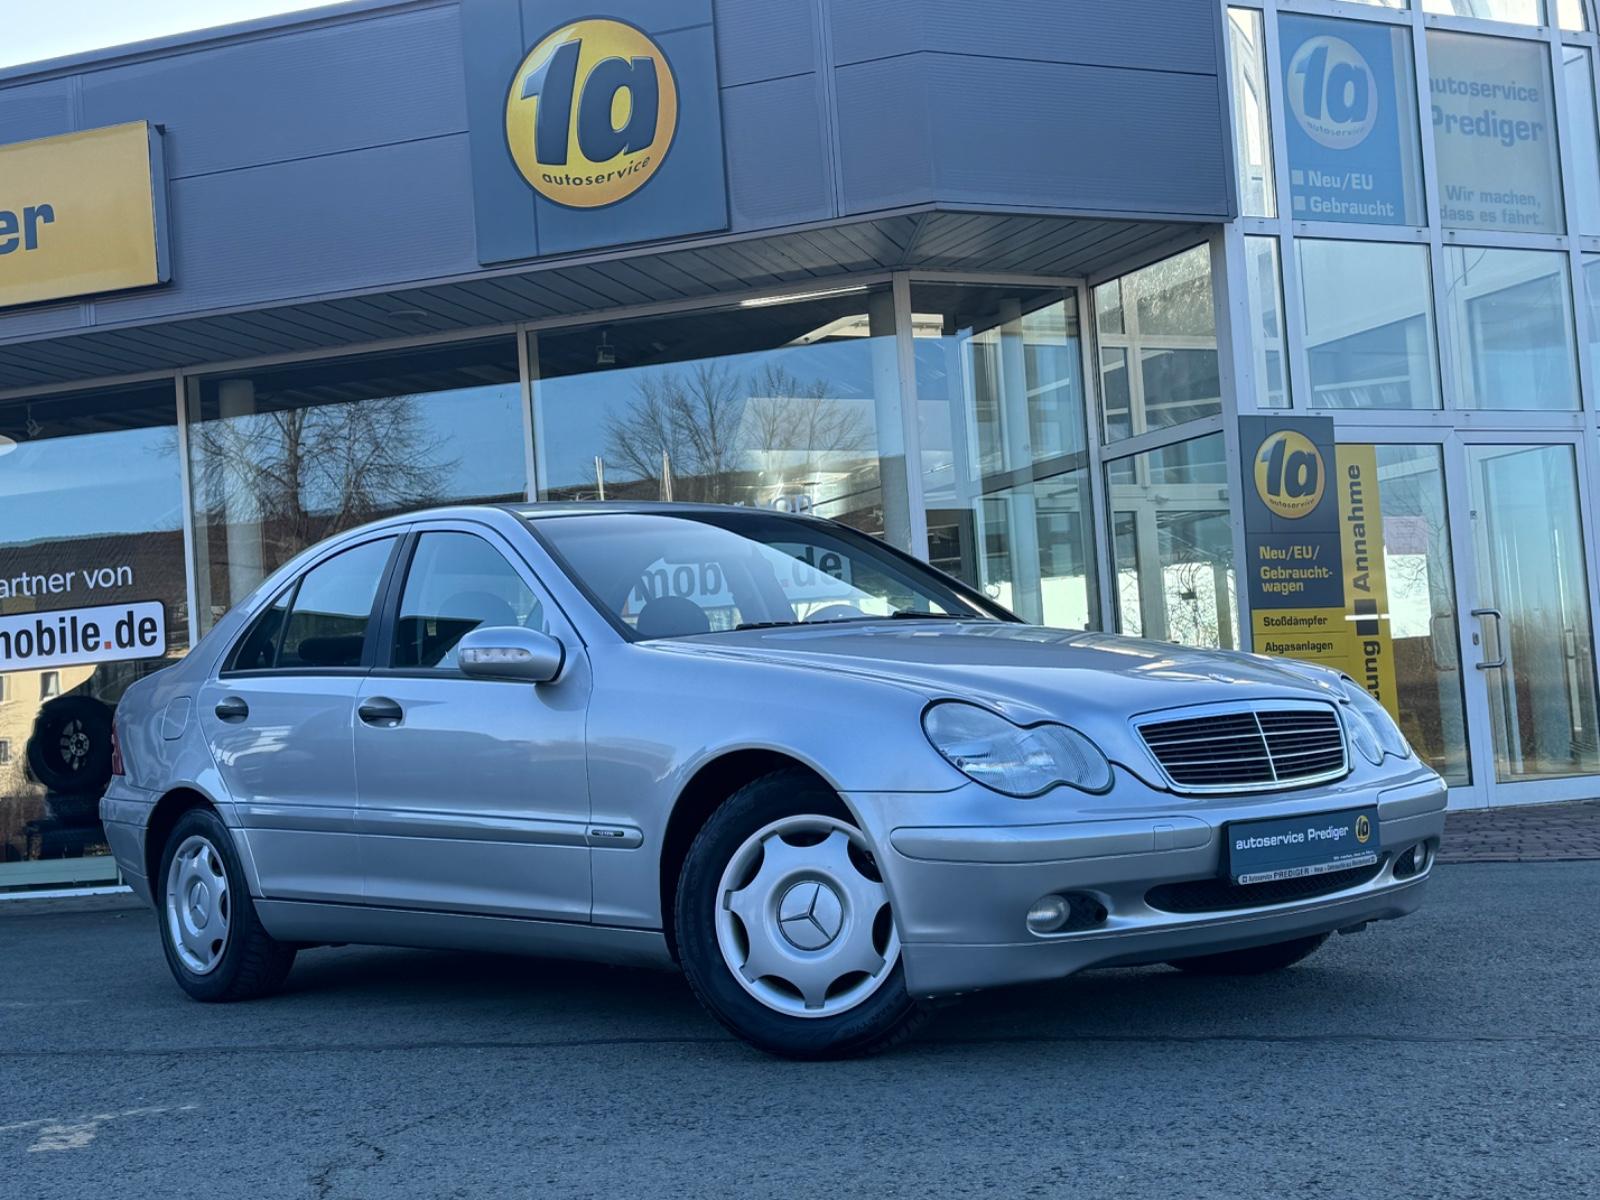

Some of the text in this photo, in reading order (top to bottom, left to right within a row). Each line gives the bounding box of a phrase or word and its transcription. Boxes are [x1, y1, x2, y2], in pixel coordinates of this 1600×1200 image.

[1295, 46, 1369, 124] 1a
[520, 38, 659, 166] 1a
[542, 156, 651, 186] autoservice
[1308, 170, 1373, 190] Neu/EU
[1311, 196, 1395, 217] Gebraucht
[1445, 185, 1541, 208] Wir machen,
[1440, 205, 1545, 225] dass es fährt.
[1261, 438, 1318, 498] 1a
[1348, 464, 1371, 592] Annahme
[1260, 545, 1320, 560] Neu/EU/
[83, 565, 133, 589] von
[1261, 565, 1333, 579] Gebraucht-
[1262, 582, 1304, 595] wagen
[1265, 641, 1334, 654] Abgasanlagen
[1236, 831, 1304, 850] autoservice
[1307, 825, 1349, 841] Prediger
